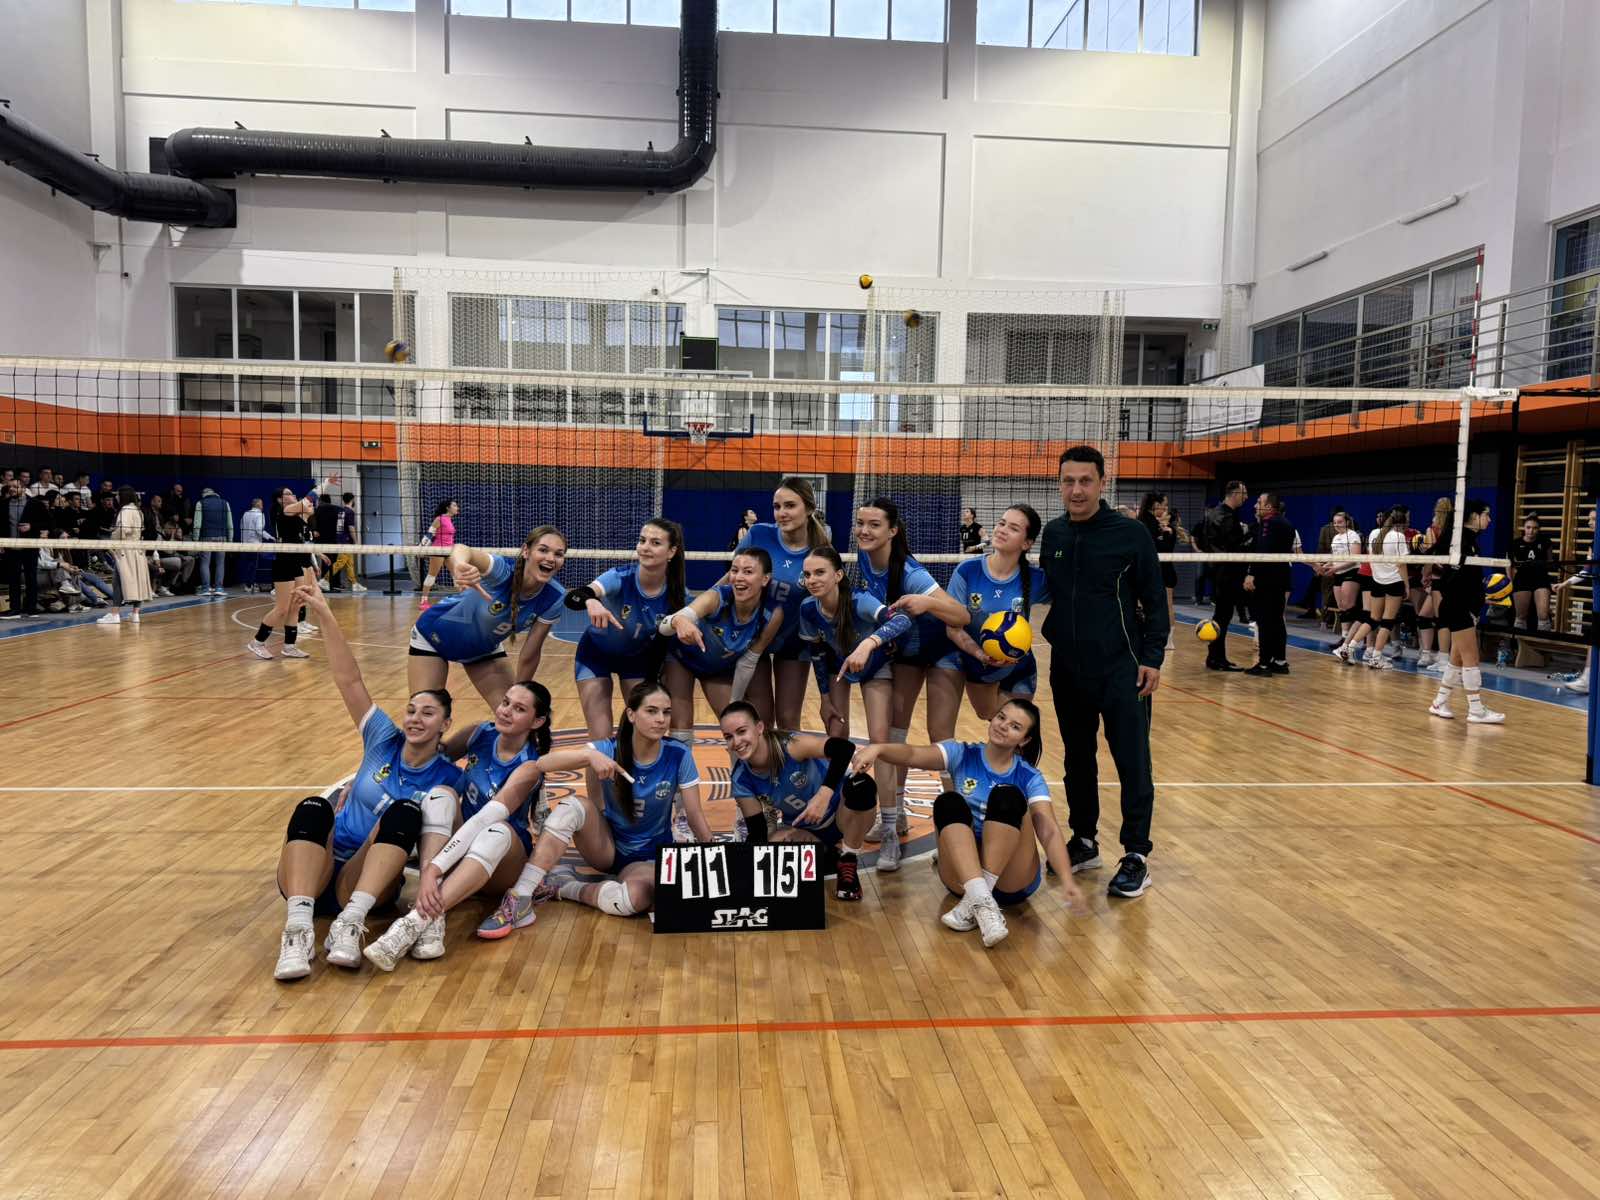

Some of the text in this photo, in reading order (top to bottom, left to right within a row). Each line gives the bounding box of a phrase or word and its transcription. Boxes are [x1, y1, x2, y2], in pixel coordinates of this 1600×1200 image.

[1527, 549, 1535, 560] 4
[771, 580, 791, 601] 12
[784, 794, 806, 810] 6
[664, 852, 673, 883] 1
[756, 851, 796, 896] 15
[803, 850, 815, 879] 2
[711, 907, 768, 928] STAG
